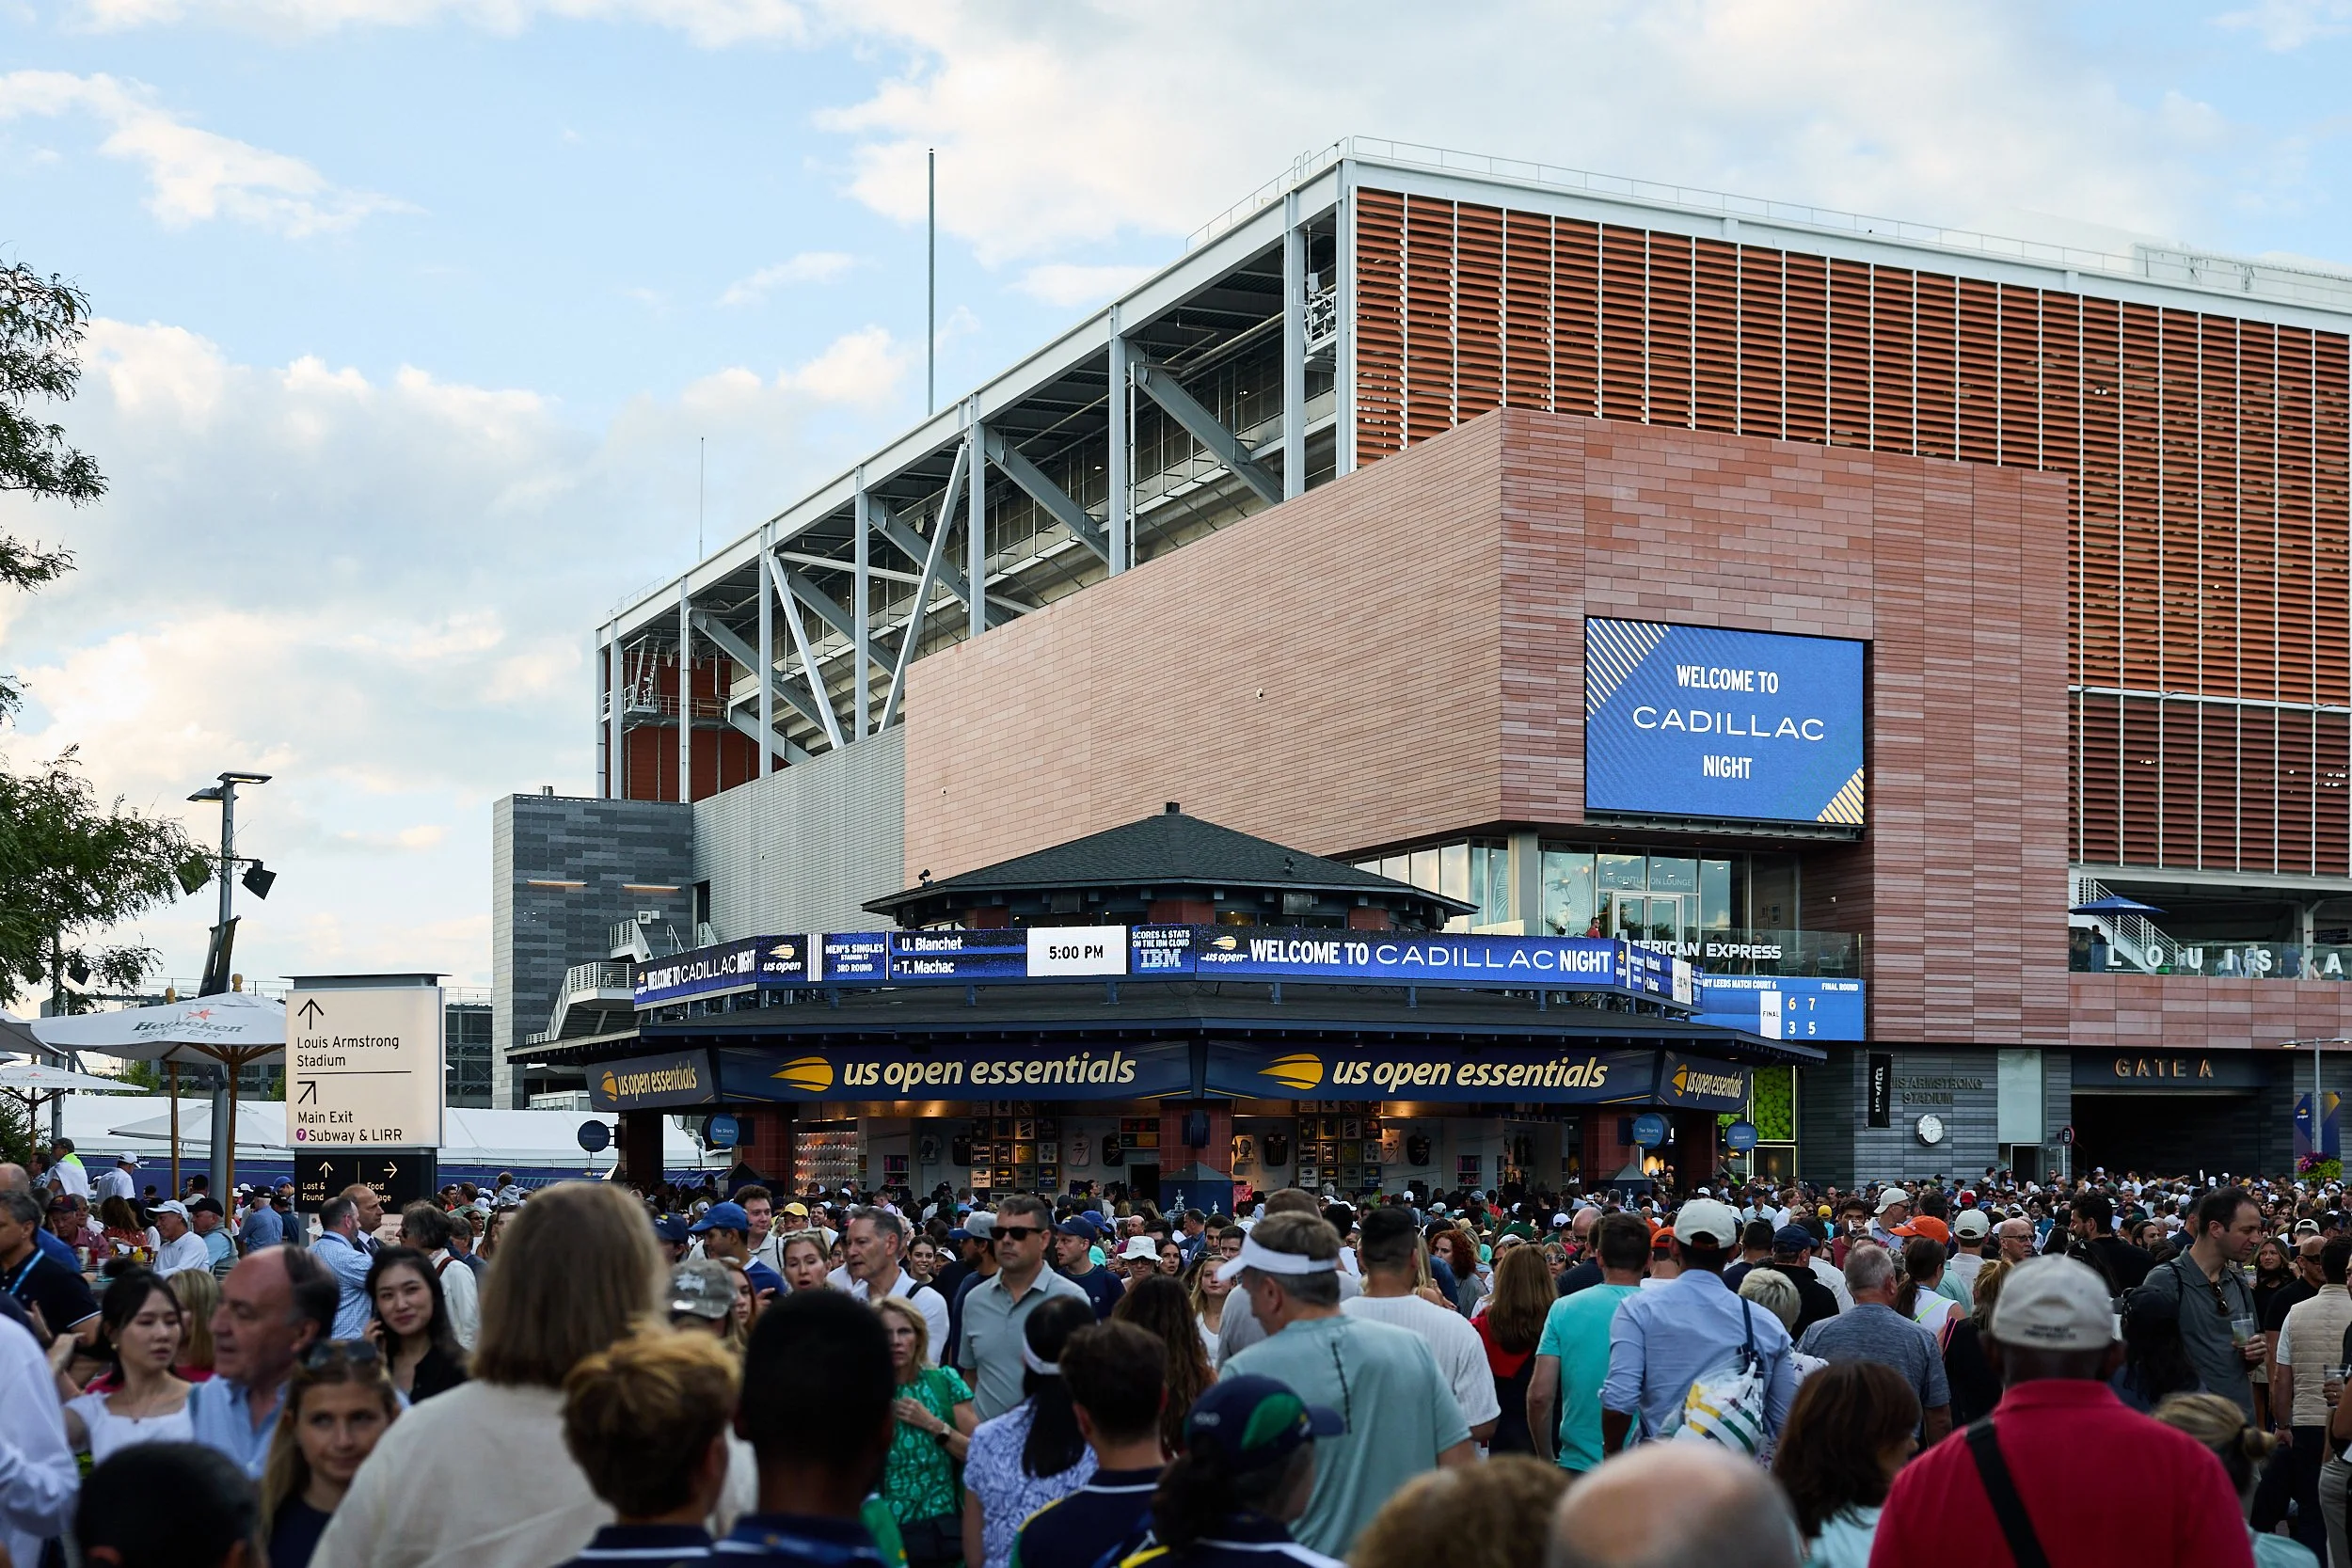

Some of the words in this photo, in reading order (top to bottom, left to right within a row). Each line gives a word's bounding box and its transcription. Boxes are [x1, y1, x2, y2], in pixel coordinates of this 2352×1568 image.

[1677, 664, 1754, 691] WELCOME
[1758, 672, 1779, 694] TO
[1632, 705, 1824, 741] CADILLAC
[1703, 754, 1752, 779] NIGHT
[1132, 930, 1160, 939] SCORES
[1161, 930, 1167, 939] &
[1168, 929, 1190, 939] STATS
[825, 943, 850, 954] MEN'S
[851, 943, 884, 954] SINGLES
[901, 938, 913, 951] U.
[915, 936, 962, 951] Blanchet
[1168, 939, 1189, 947] CLOUD
[1049, 945, 1079, 959] 5:00
[1084, 945, 1104, 958] PM
[1140, 948, 1181, 968] IBM
[1218, 953, 1244, 963] open
[1249, 939, 1341, 965] WELCOME
[1343, 942, 1369, 966] TO
[1375, 944, 1554, 970] CADILLAC
[1559, 948, 1612, 974] NIGHT
[1706, 943, 1782, 959] EXPRESS
[2107, 944, 2273, 973] LOUIS
[647, 968, 672, 991] WELCOME
[672, 966, 681, 987] TO
[680, 955, 737, 984] CADILLAC
[737, 949, 756, 974] NIGHT
[763, 961, 775, 972] us
[775, 960, 802, 974] open
[837, 963, 850, 972] 3RD
[850, 963, 873, 972] ROUND
[901, 960, 912, 974] T.
[914, 958, 955, 974] Machac
[1713, 978, 1731, 989] LEEDS
[1731, 980, 1752, 989] MATCH
[1753, 981, 1772, 990] COURT
[1772, 981, 1777, 990] 6
[1838, 983, 1859, 991] ROUND
[1788, 997, 1797, 1010] 6
[1808, 998, 1816, 1010] 7
[1788, 1021, 1796, 1035] 3
[1808, 1022, 1816, 1035] 5
[297, 1036, 328, 1049] Louis
[332, 1035, 399, 1050] Armstrong
[297, 1054, 346, 1067] Stadium
[844, 1062, 880, 1085] us
[883, 1061, 962, 1093] open
[970, 1052, 1136, 1085] essentials
[1332, 1061, 1371, 1085] us
[1373, 1062, 1452, 1093] open
[1456, 1056, 1609, 1088] essentials
[2115, 1058, 2187, 1078] GATE
[2199, 1058, 2214, 1078] A
[617, 1074, 628, 1097] us
[628, 1072, 651, 1101] open
[651, 1059, 697, 1093] essentials
[1686, 1071, 1697, 1092] us
[1694, 1072, 1712, 1101] open
[1711, 1071, 1743, 1099] essentials
[1910, 1076, 1983, 1089] ARMSTRONG
[1903, 1091, 1953, 1104] STADIUM
[297, 1111, 326, 1124] Main
[329, 1111, 354, 1123] Exit
[309, 1130, 355, 1144] Subway
[359, 1130, 368, 1141] &
[372, 1129, 403, 1141] LIRR
[367, 1181, 385, 1190] Food
[302, 1193, 325, 1201] Found
